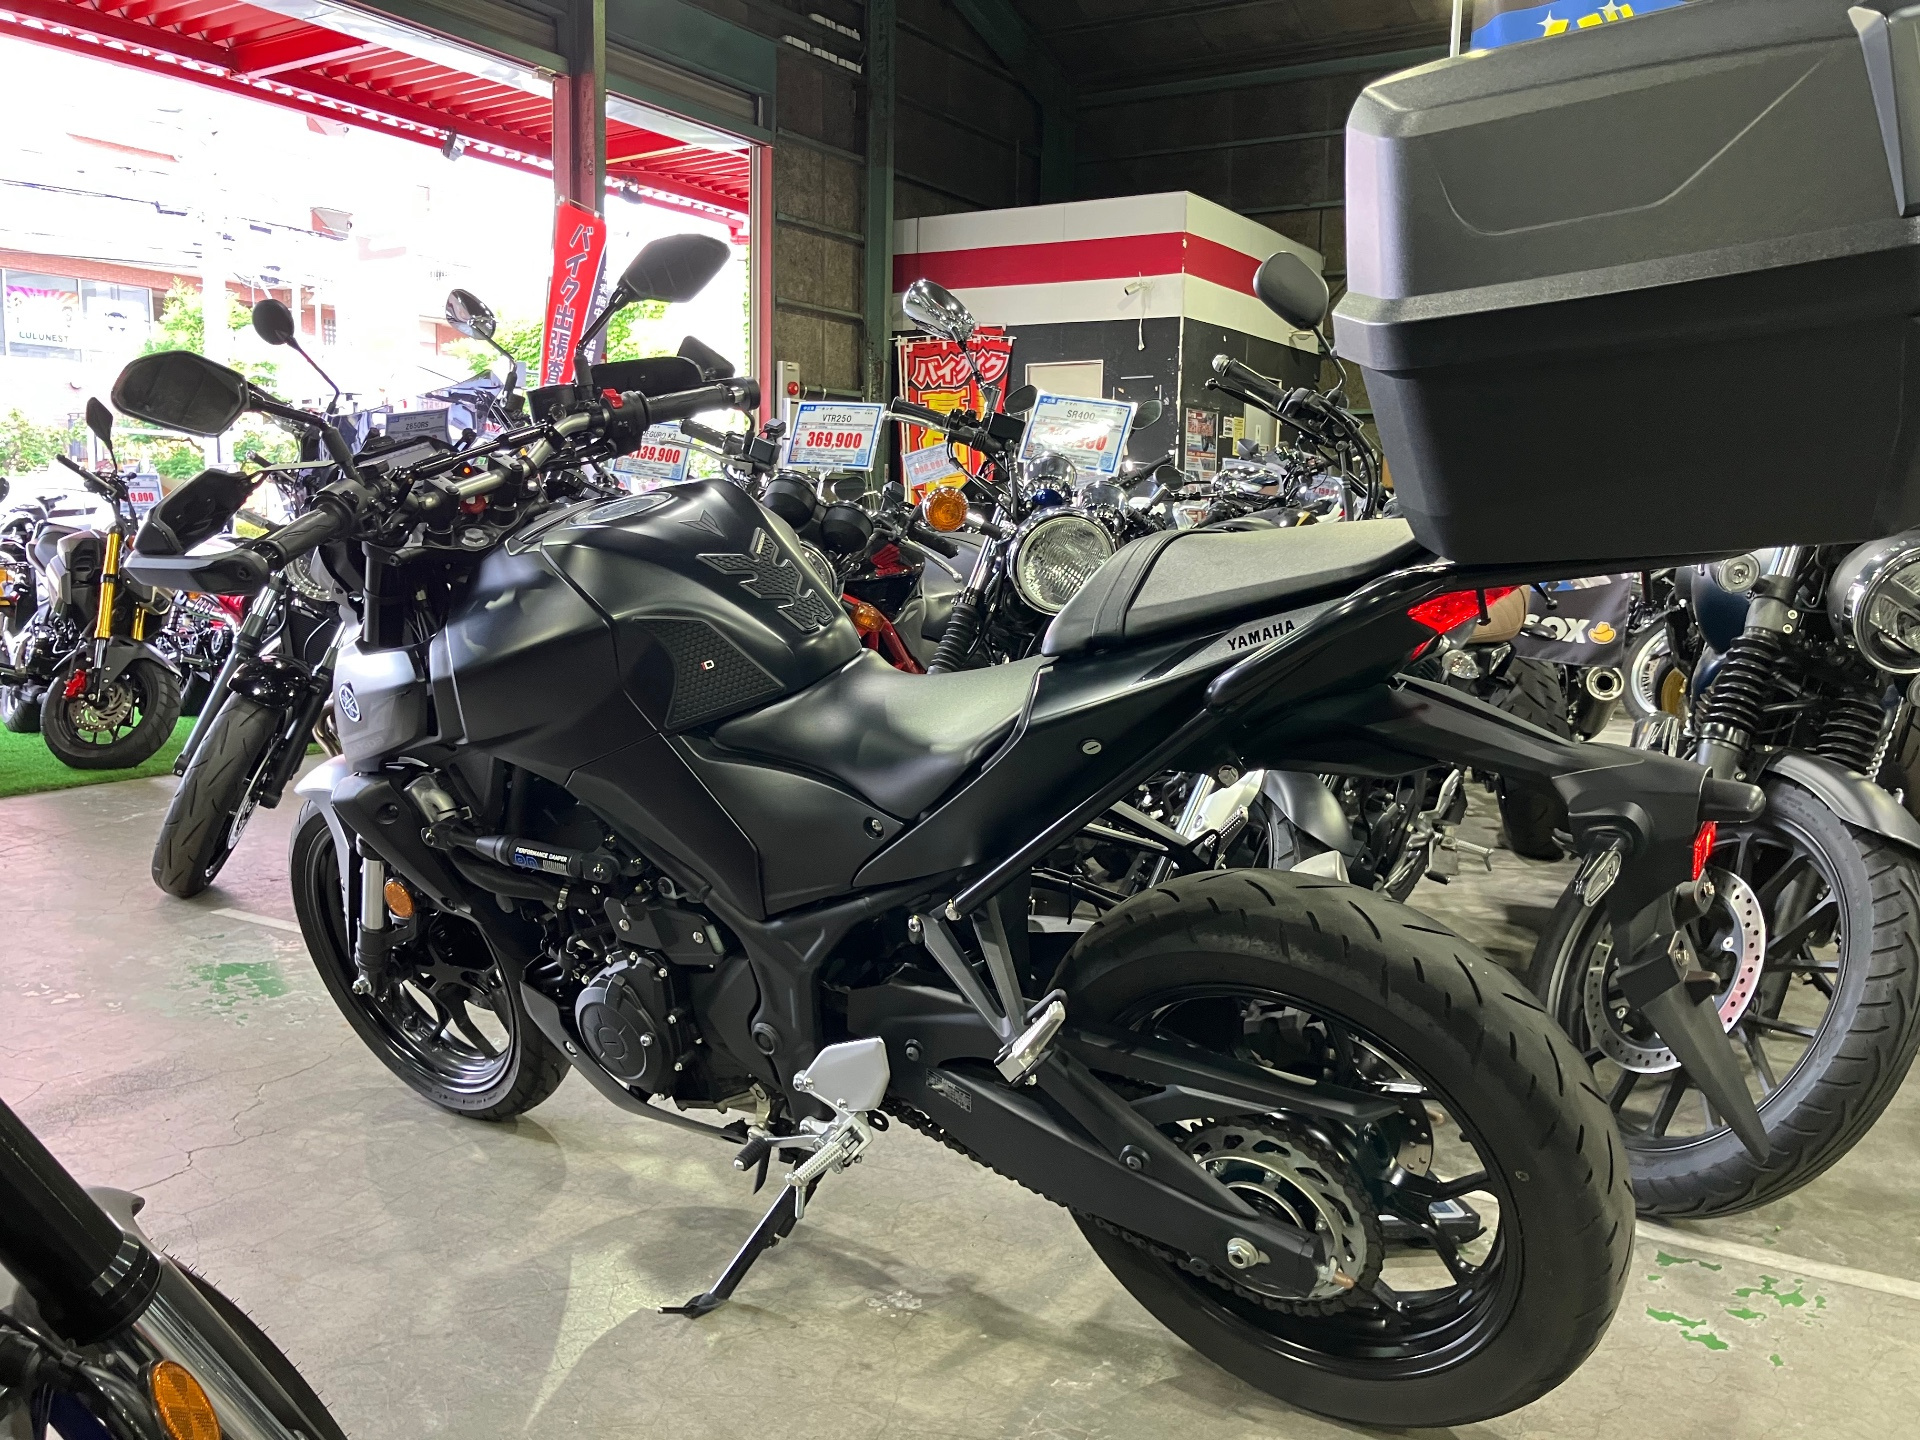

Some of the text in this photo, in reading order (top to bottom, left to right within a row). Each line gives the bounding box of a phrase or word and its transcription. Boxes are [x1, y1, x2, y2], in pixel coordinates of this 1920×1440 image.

[19, 331, 69, 343] LULUNEST
[822, 414, 852, 423] VTR250
[1066, 409, 1096, 420] SR400
[806, 431, 863, 449] 369,900
[1227, 620, 1295, 651] YAMAHA
[515, 846, 549, 859] PERFORMANCE
